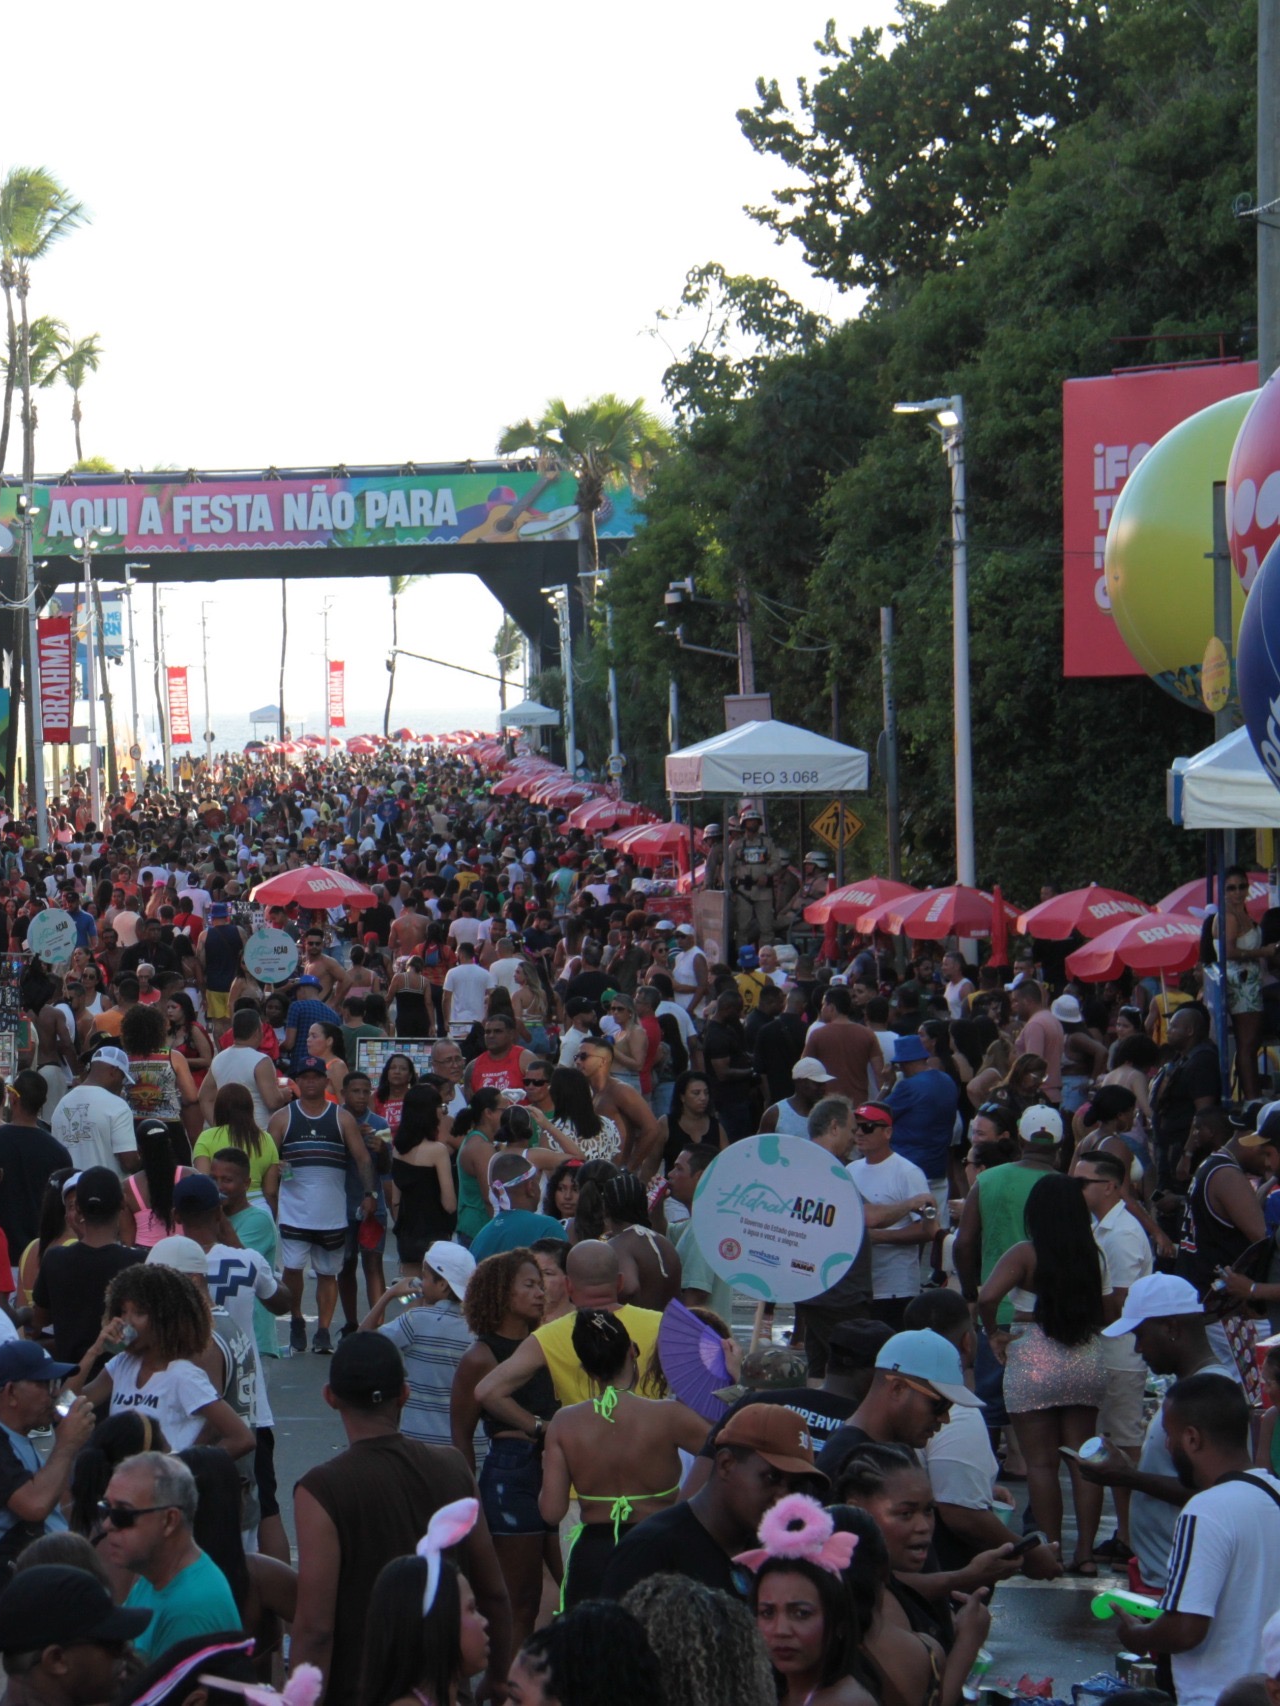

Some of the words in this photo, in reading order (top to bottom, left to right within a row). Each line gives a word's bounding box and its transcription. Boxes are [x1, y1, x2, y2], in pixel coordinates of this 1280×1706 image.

[48, 498, 128, 537] AQUI
[138, 497, 163, 535] A
[173, 494, 274, 534] FESTA
[284, 485, 355, 531] NÃO
[365, 488, 458, 528] PARA
[40, 633, 70, 729] BRAHMA
[169, 676, 190, 735] BRAHMA
[742, 772, 775, 785] PEO
[780, 771, 819, 784] 3.068
